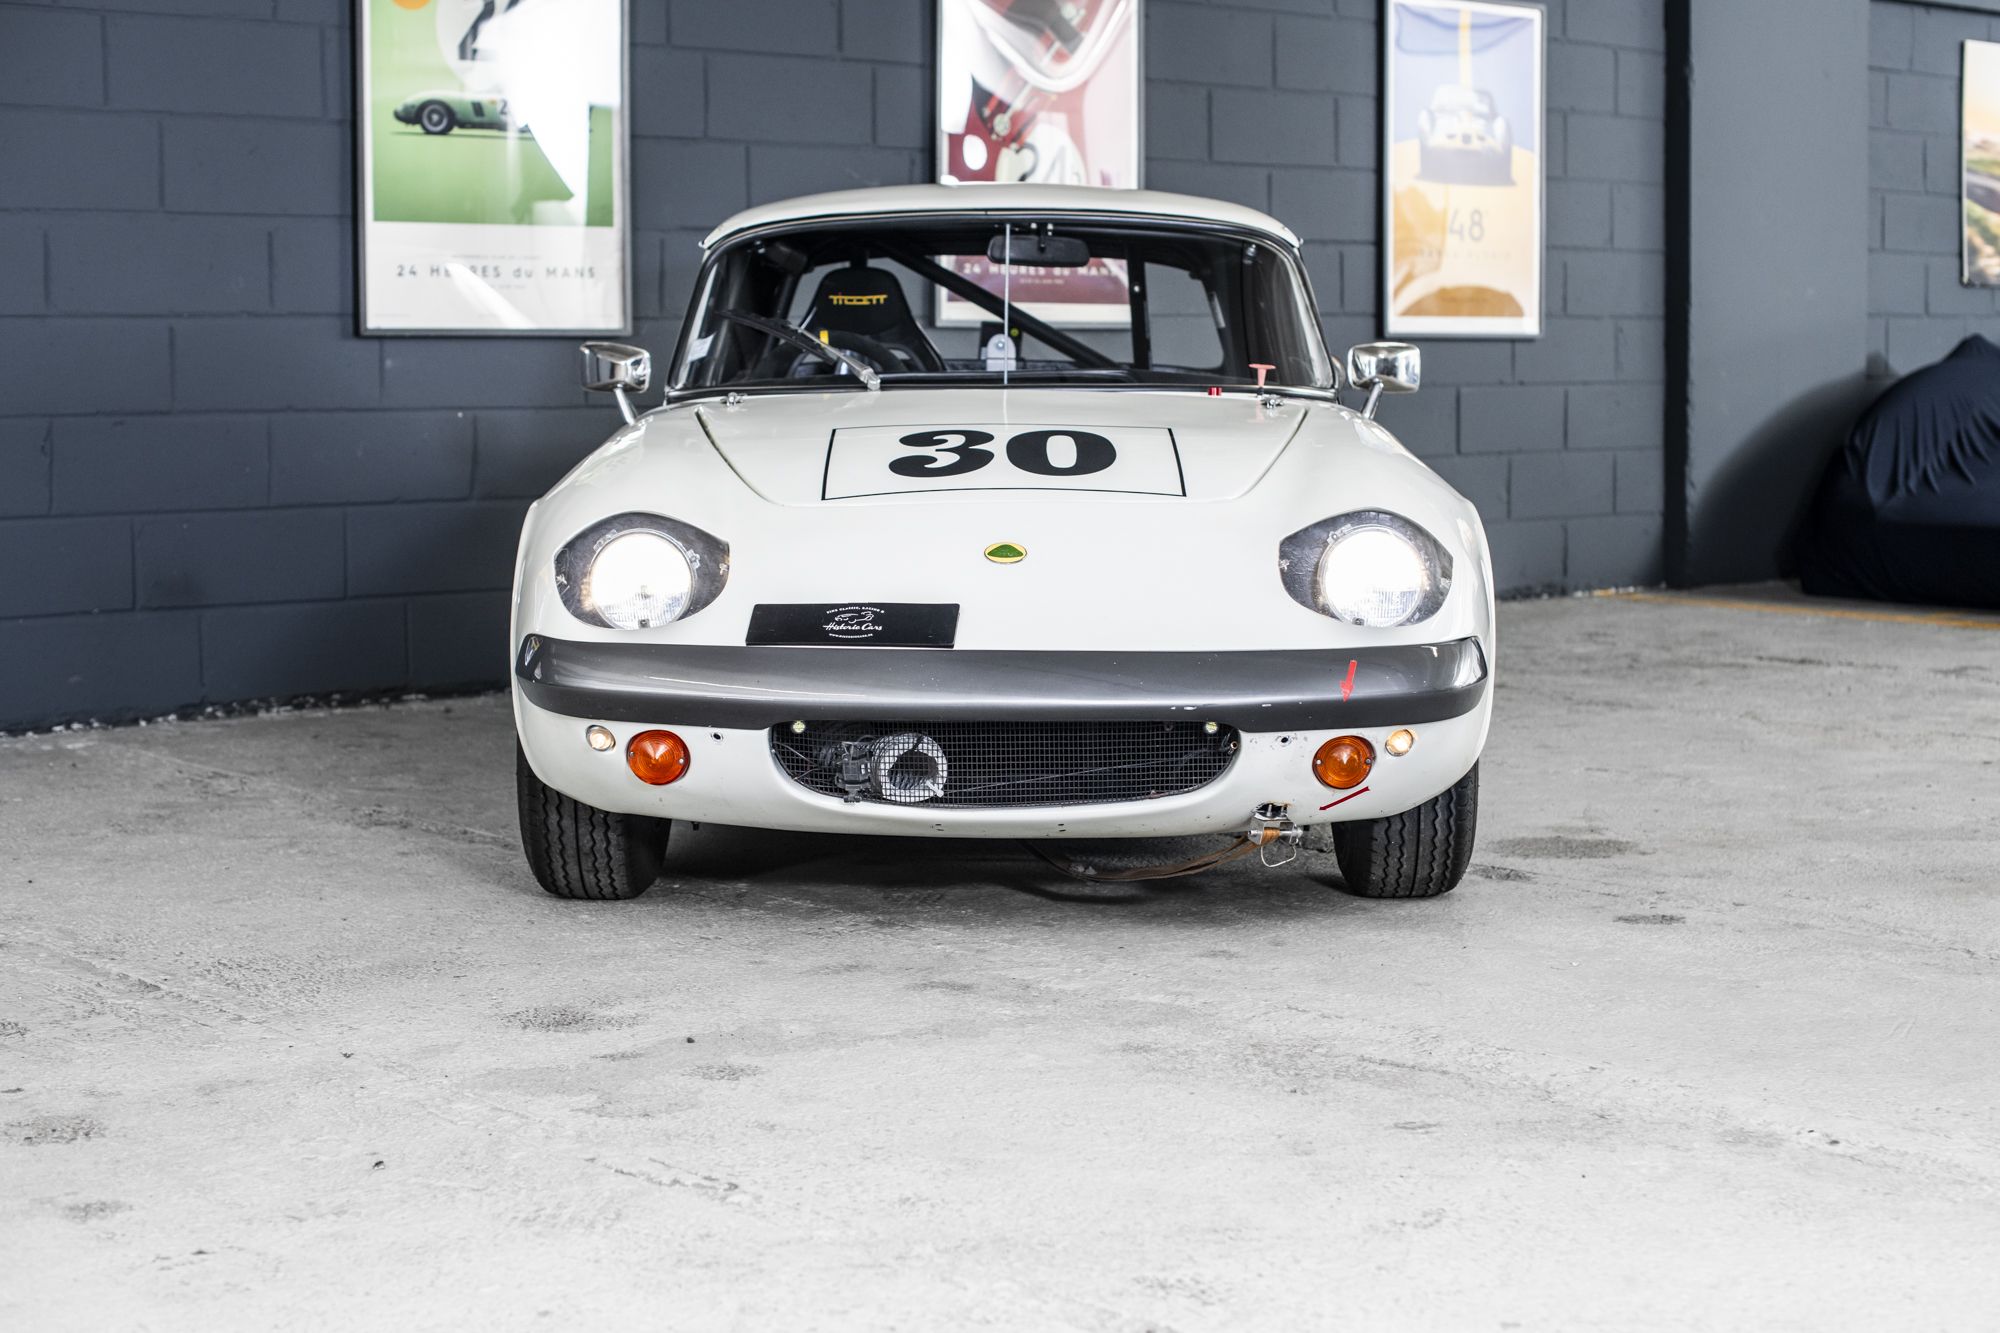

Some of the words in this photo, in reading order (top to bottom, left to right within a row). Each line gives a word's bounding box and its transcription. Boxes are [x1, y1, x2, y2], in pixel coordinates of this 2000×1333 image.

[1449, 208, 1485, 242] 48
[396, 264, 418, 277] 24
[430, 265, 501, 278] HERES
[512, 266, 533, 278] du
[545, 266, 596, 279] MANS
[963, 262, 981, 274] 24
[888, 430, 1117, 477] 30
[822, 621, 861, 631] Historic
[861, 622, 882, 631] Cars
